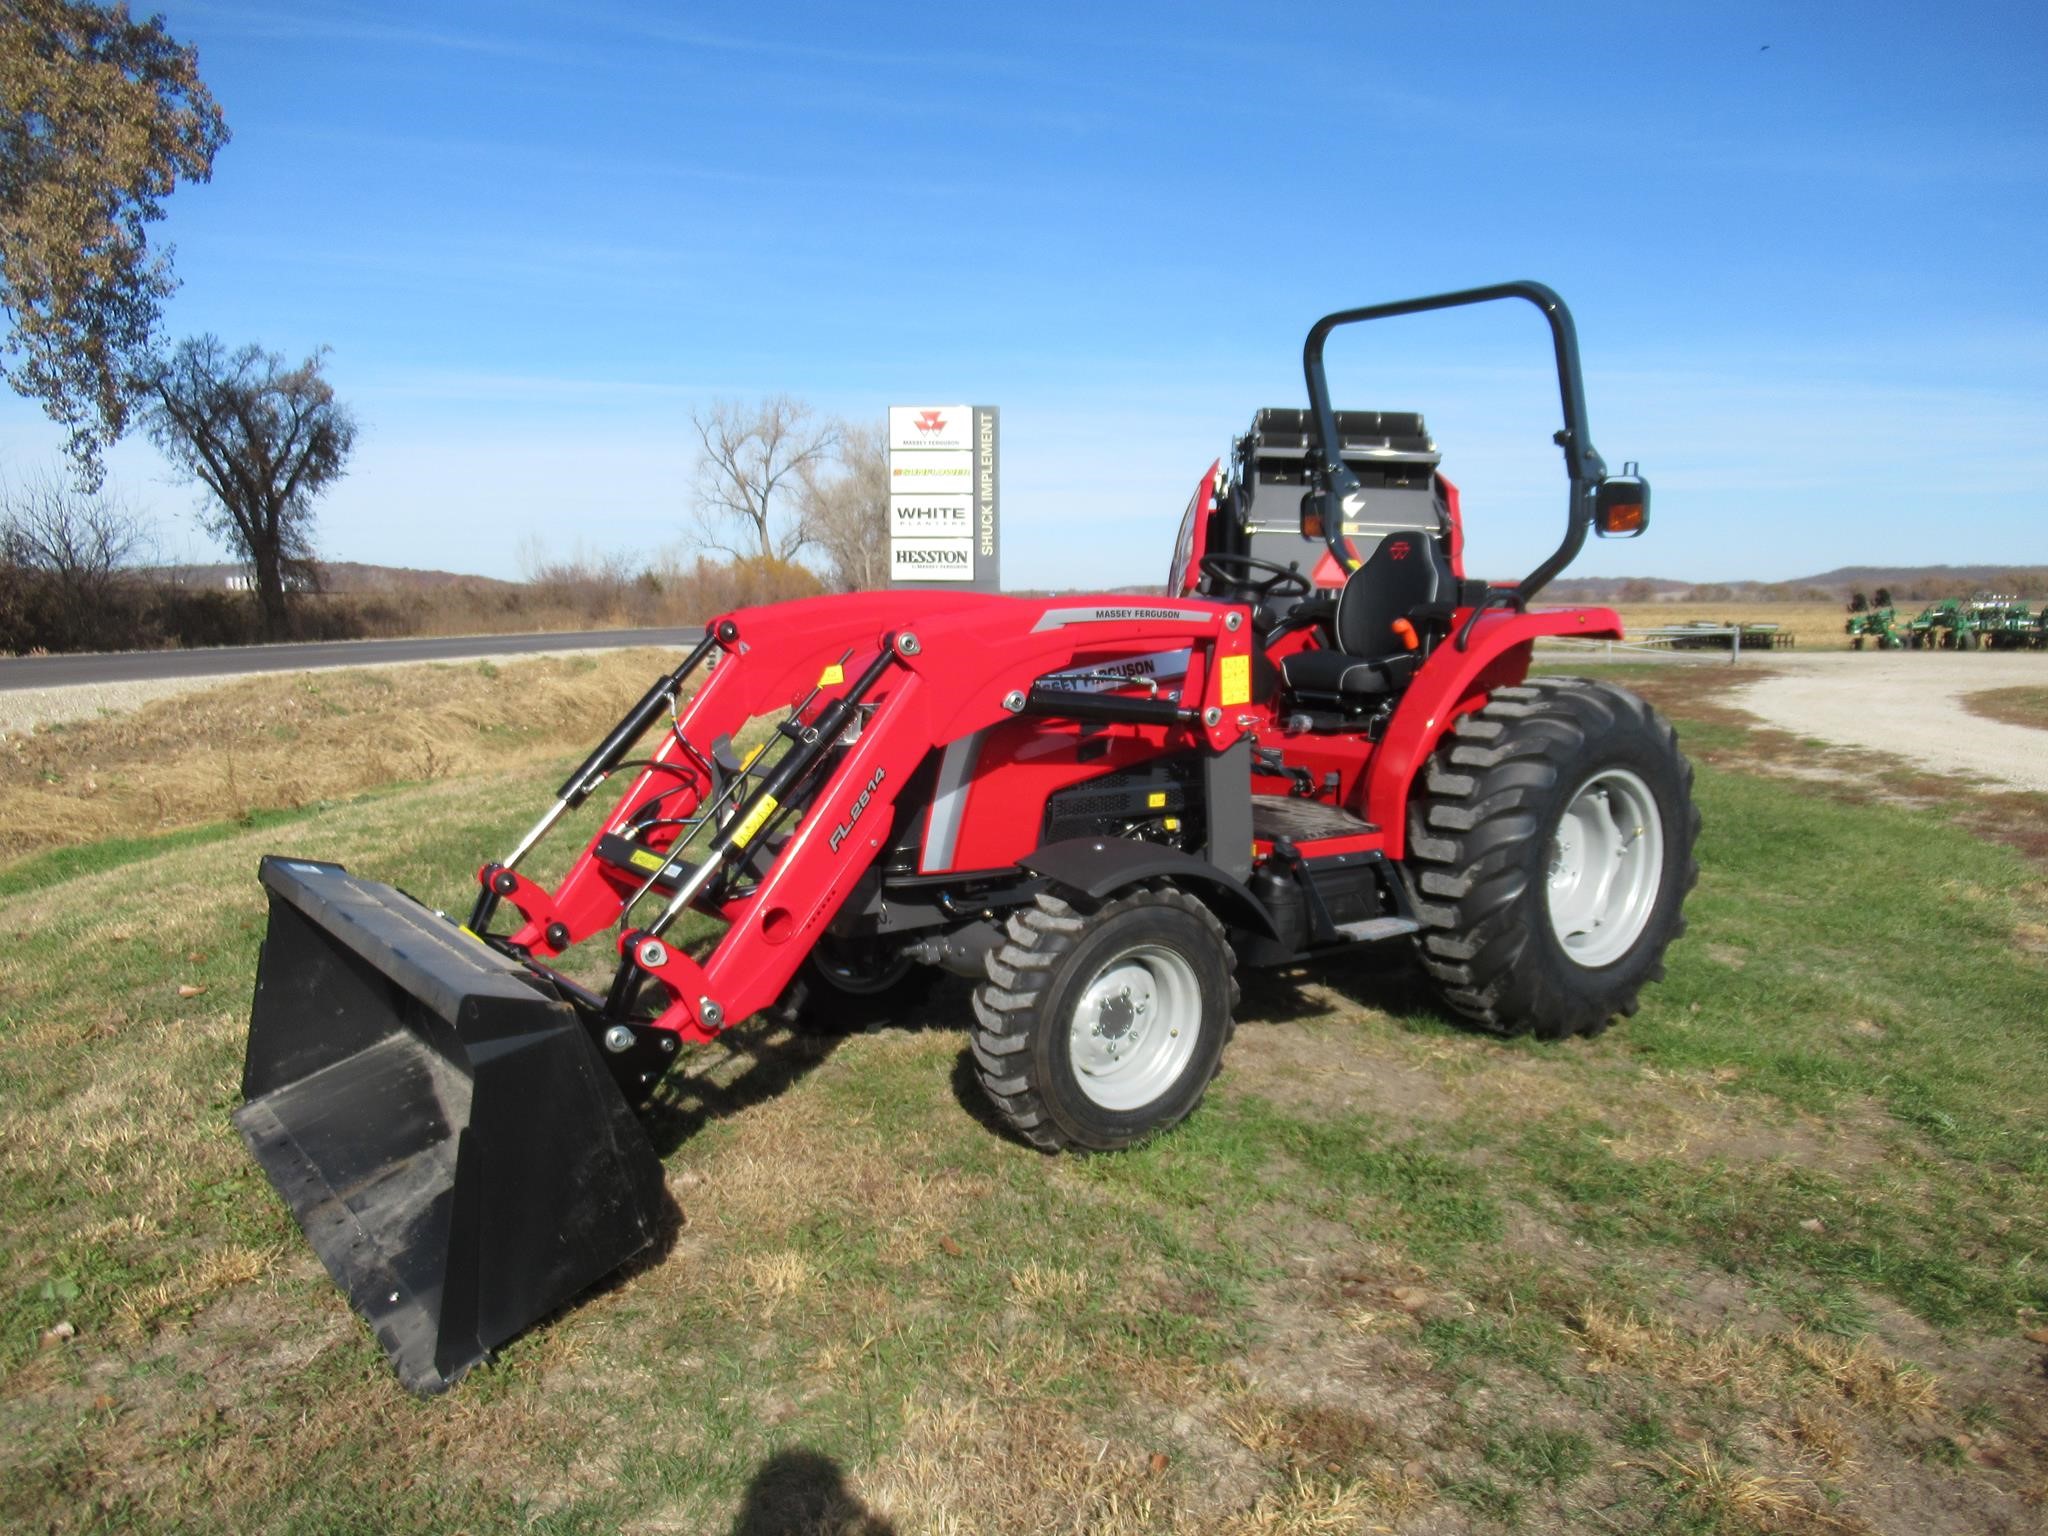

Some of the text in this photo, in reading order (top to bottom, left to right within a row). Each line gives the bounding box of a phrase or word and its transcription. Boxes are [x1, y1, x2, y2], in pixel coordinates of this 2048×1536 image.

[980, 412, 994, 557] SHUCK IMPLEMENT
[897, 507, 966, 519] WHITE
[896, 550, 968, 564] HESSTON
[1095, 609, 1180, 619] MASSEY FERGUSON
[828, 765, 886, 853] FL.2814
